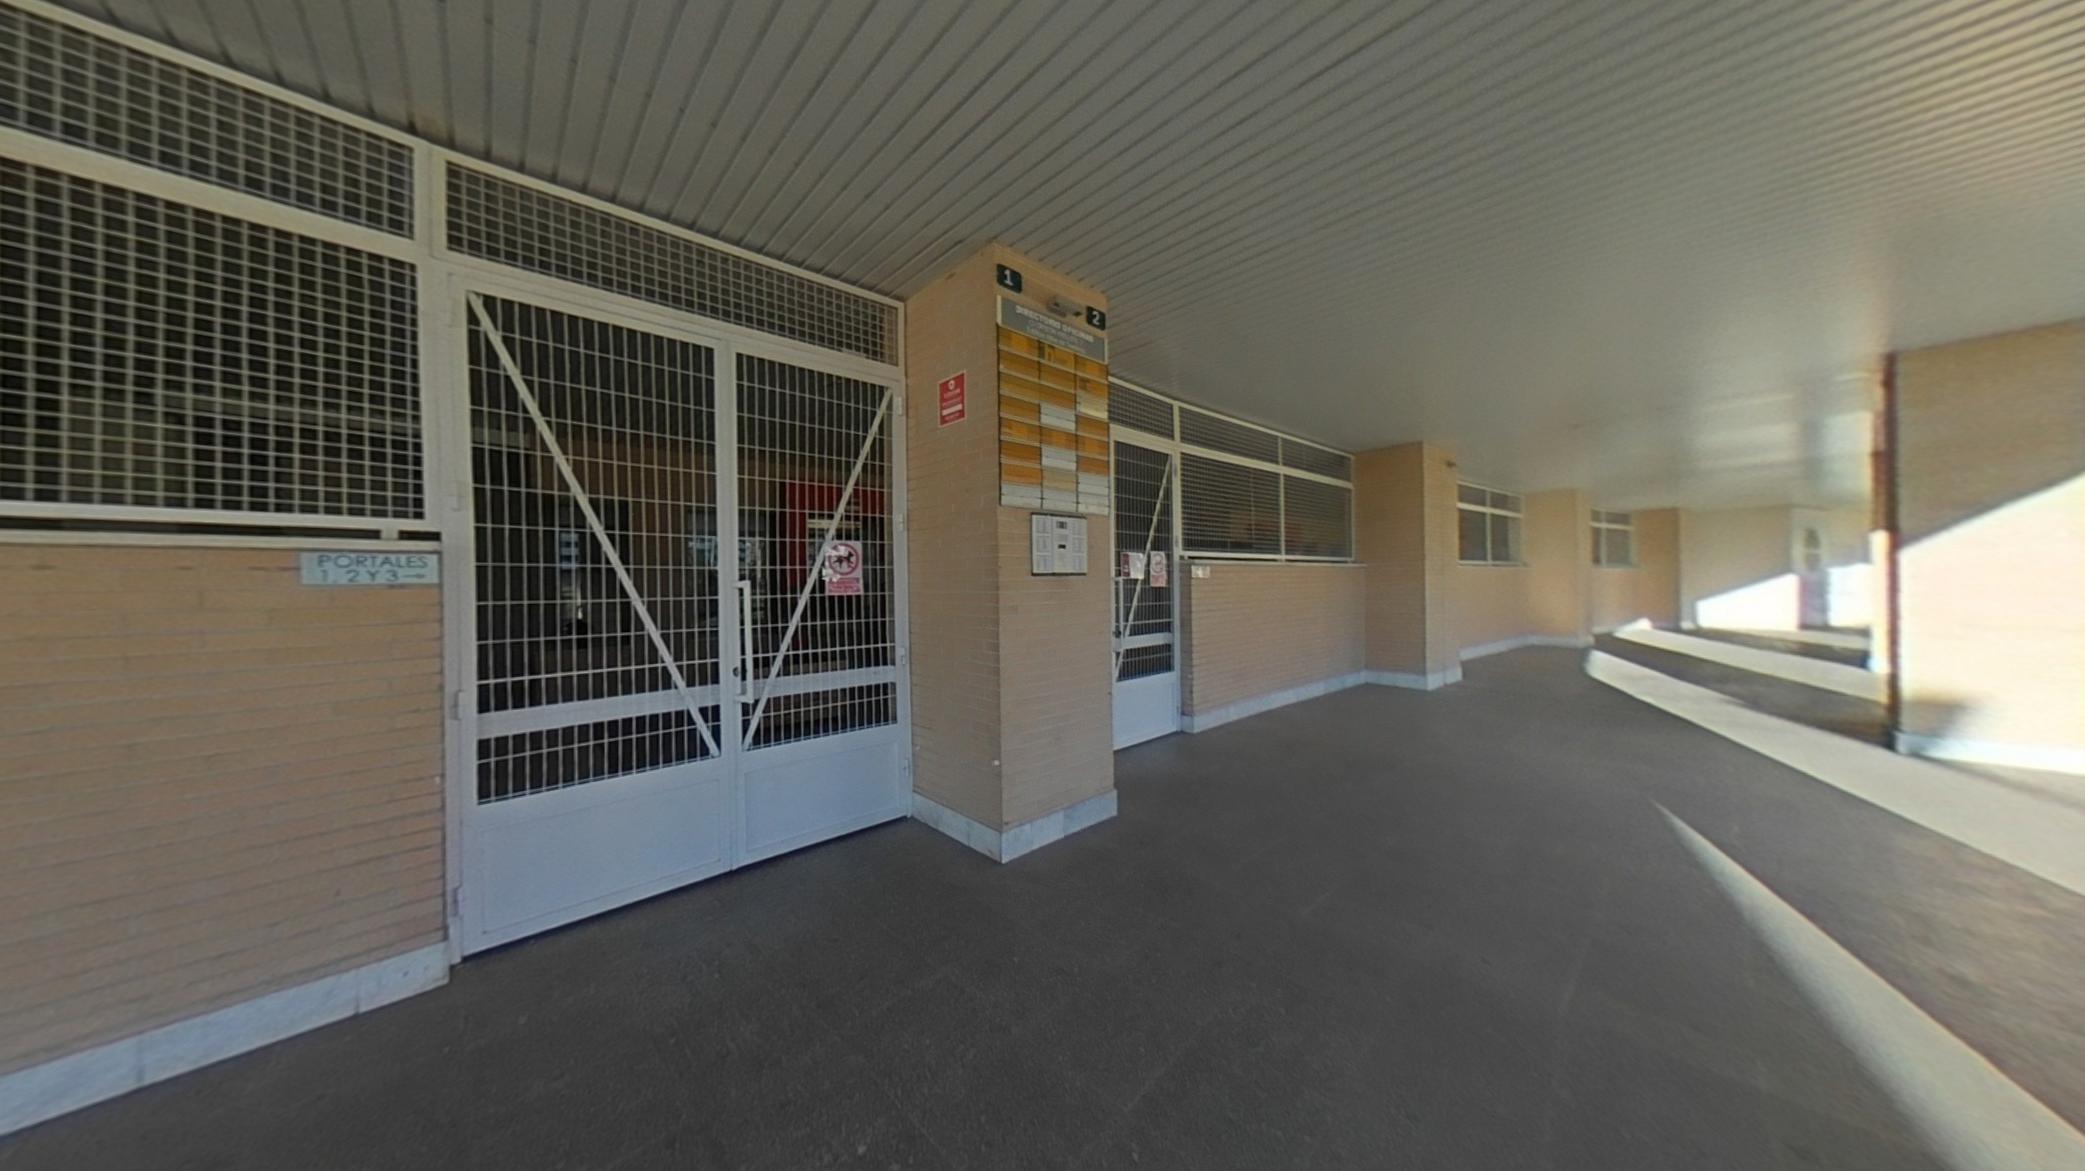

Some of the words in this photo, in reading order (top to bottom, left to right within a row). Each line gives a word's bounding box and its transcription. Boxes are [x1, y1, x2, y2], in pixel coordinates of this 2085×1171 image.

[1003, 269, 1013, 286] 1
[1091, 310, 1100, 326] 2
[317, 554, 429, 568] PORTALES
[345, 569, 360, 582] 2
[366, 569, 379, 581] Y
[384, 569, 398, 582] 3
